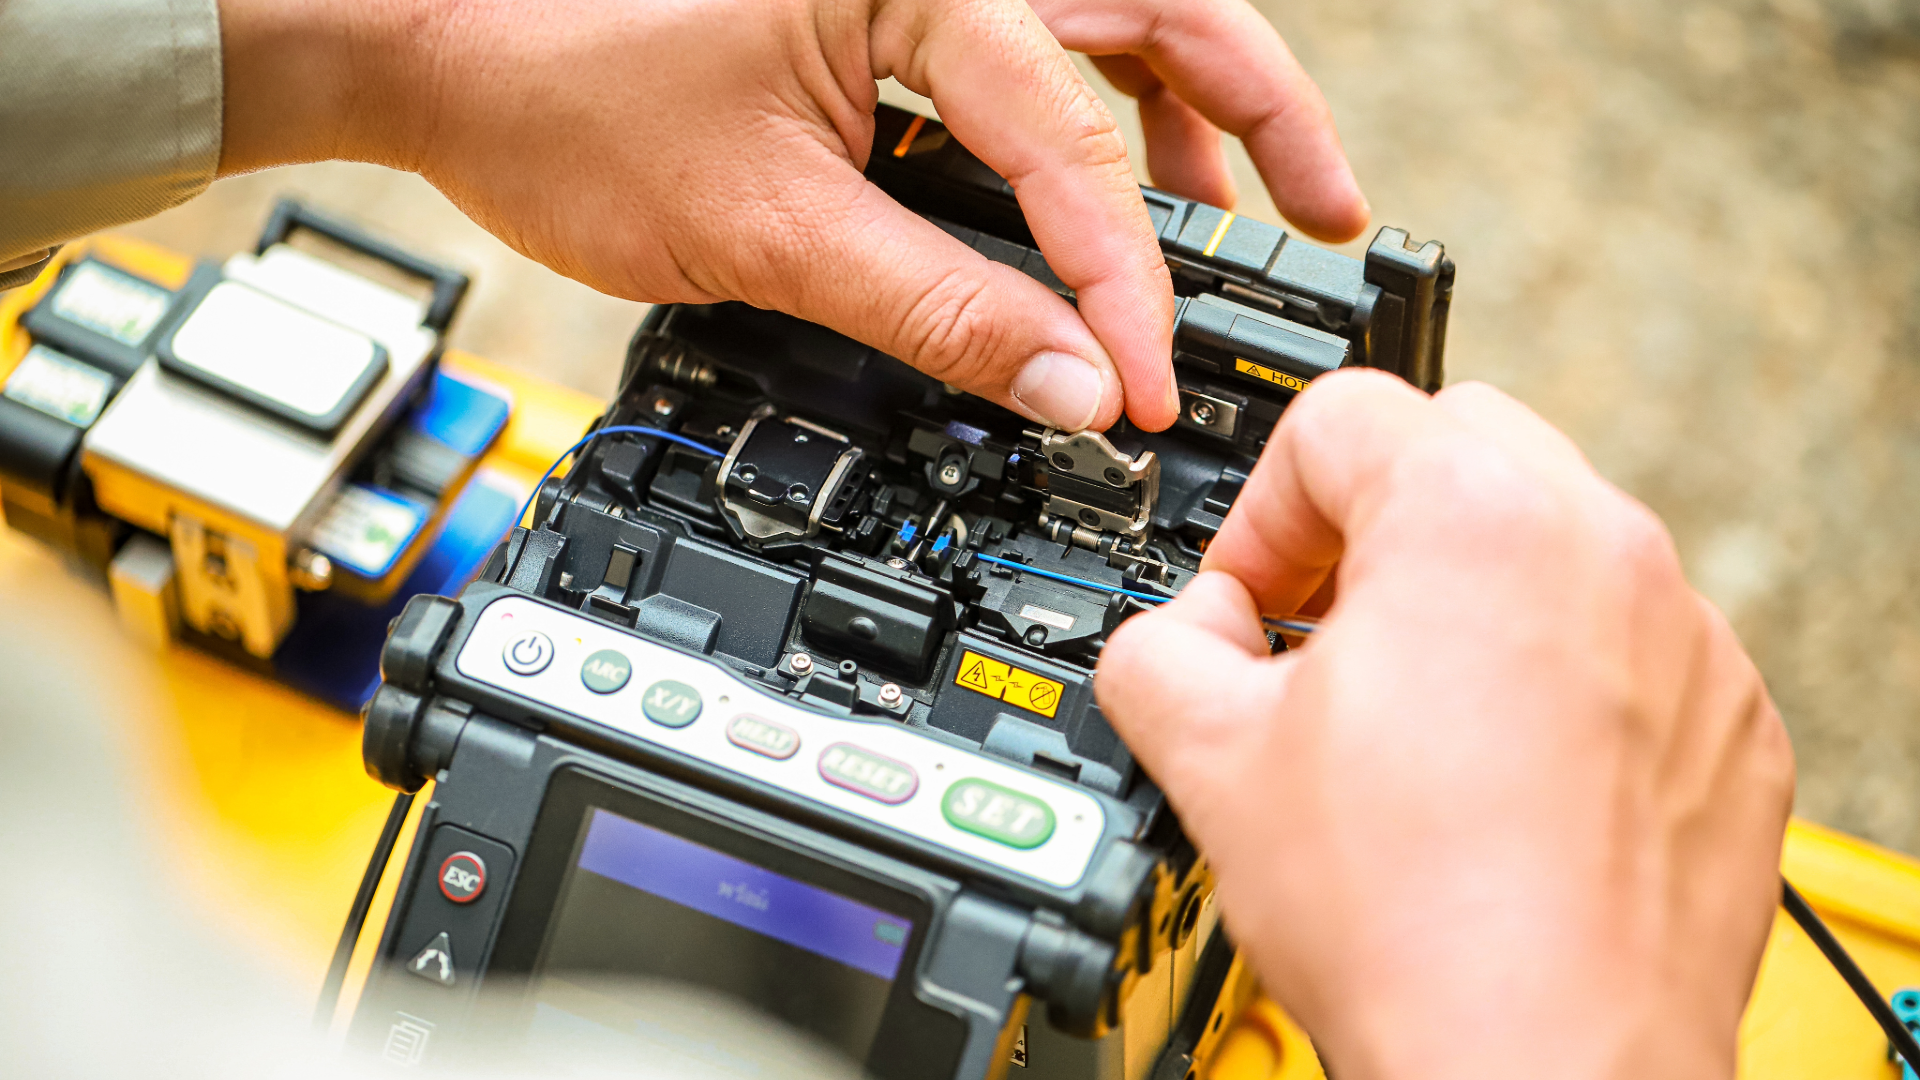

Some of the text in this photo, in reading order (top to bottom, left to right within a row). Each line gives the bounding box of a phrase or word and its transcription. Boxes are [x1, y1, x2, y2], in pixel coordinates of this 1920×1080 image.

[1272, 371, 1309, 391] HOT
[584, 659, 629, 682] ARC
[647, 687, 699, 715] X/Y
[822, 747, 911, 793] RESET
[953, 786, 1045, 833] SET
[443, 865, 481, 892] ESC
